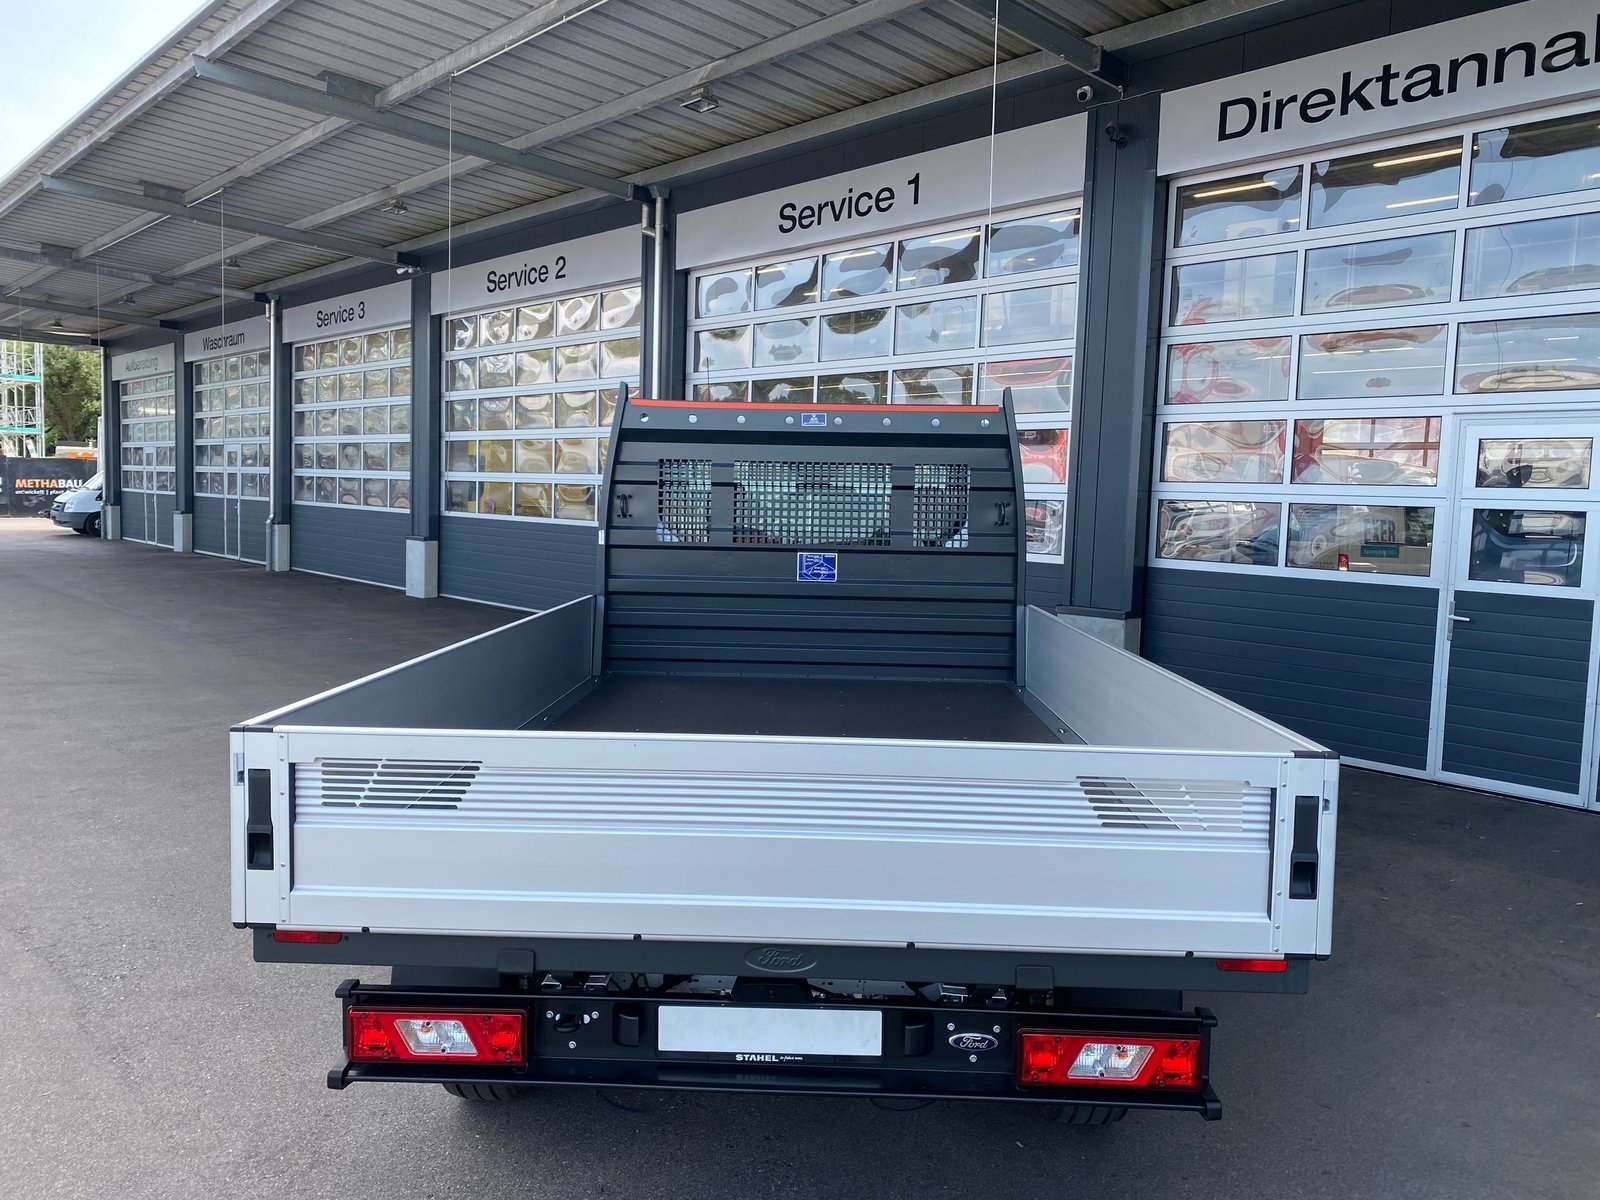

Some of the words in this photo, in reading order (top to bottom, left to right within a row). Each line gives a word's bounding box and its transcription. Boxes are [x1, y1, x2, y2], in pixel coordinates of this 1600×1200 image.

[778, 187, 895, 234] Service
[907, 172, 921, 207] 1
[486, 264, 549, 294] Service
[554, 255, 567, 281] 2
[315, 306, 355, 329] Service
[357, 301, 366, 321] 3
[15, 478, 83, 488] METHABAU
[758, 947, 804, 967] Ford
[959, 1036, 989, 1049] Ford
[735, 1053, 779, 1062] STAHEL
